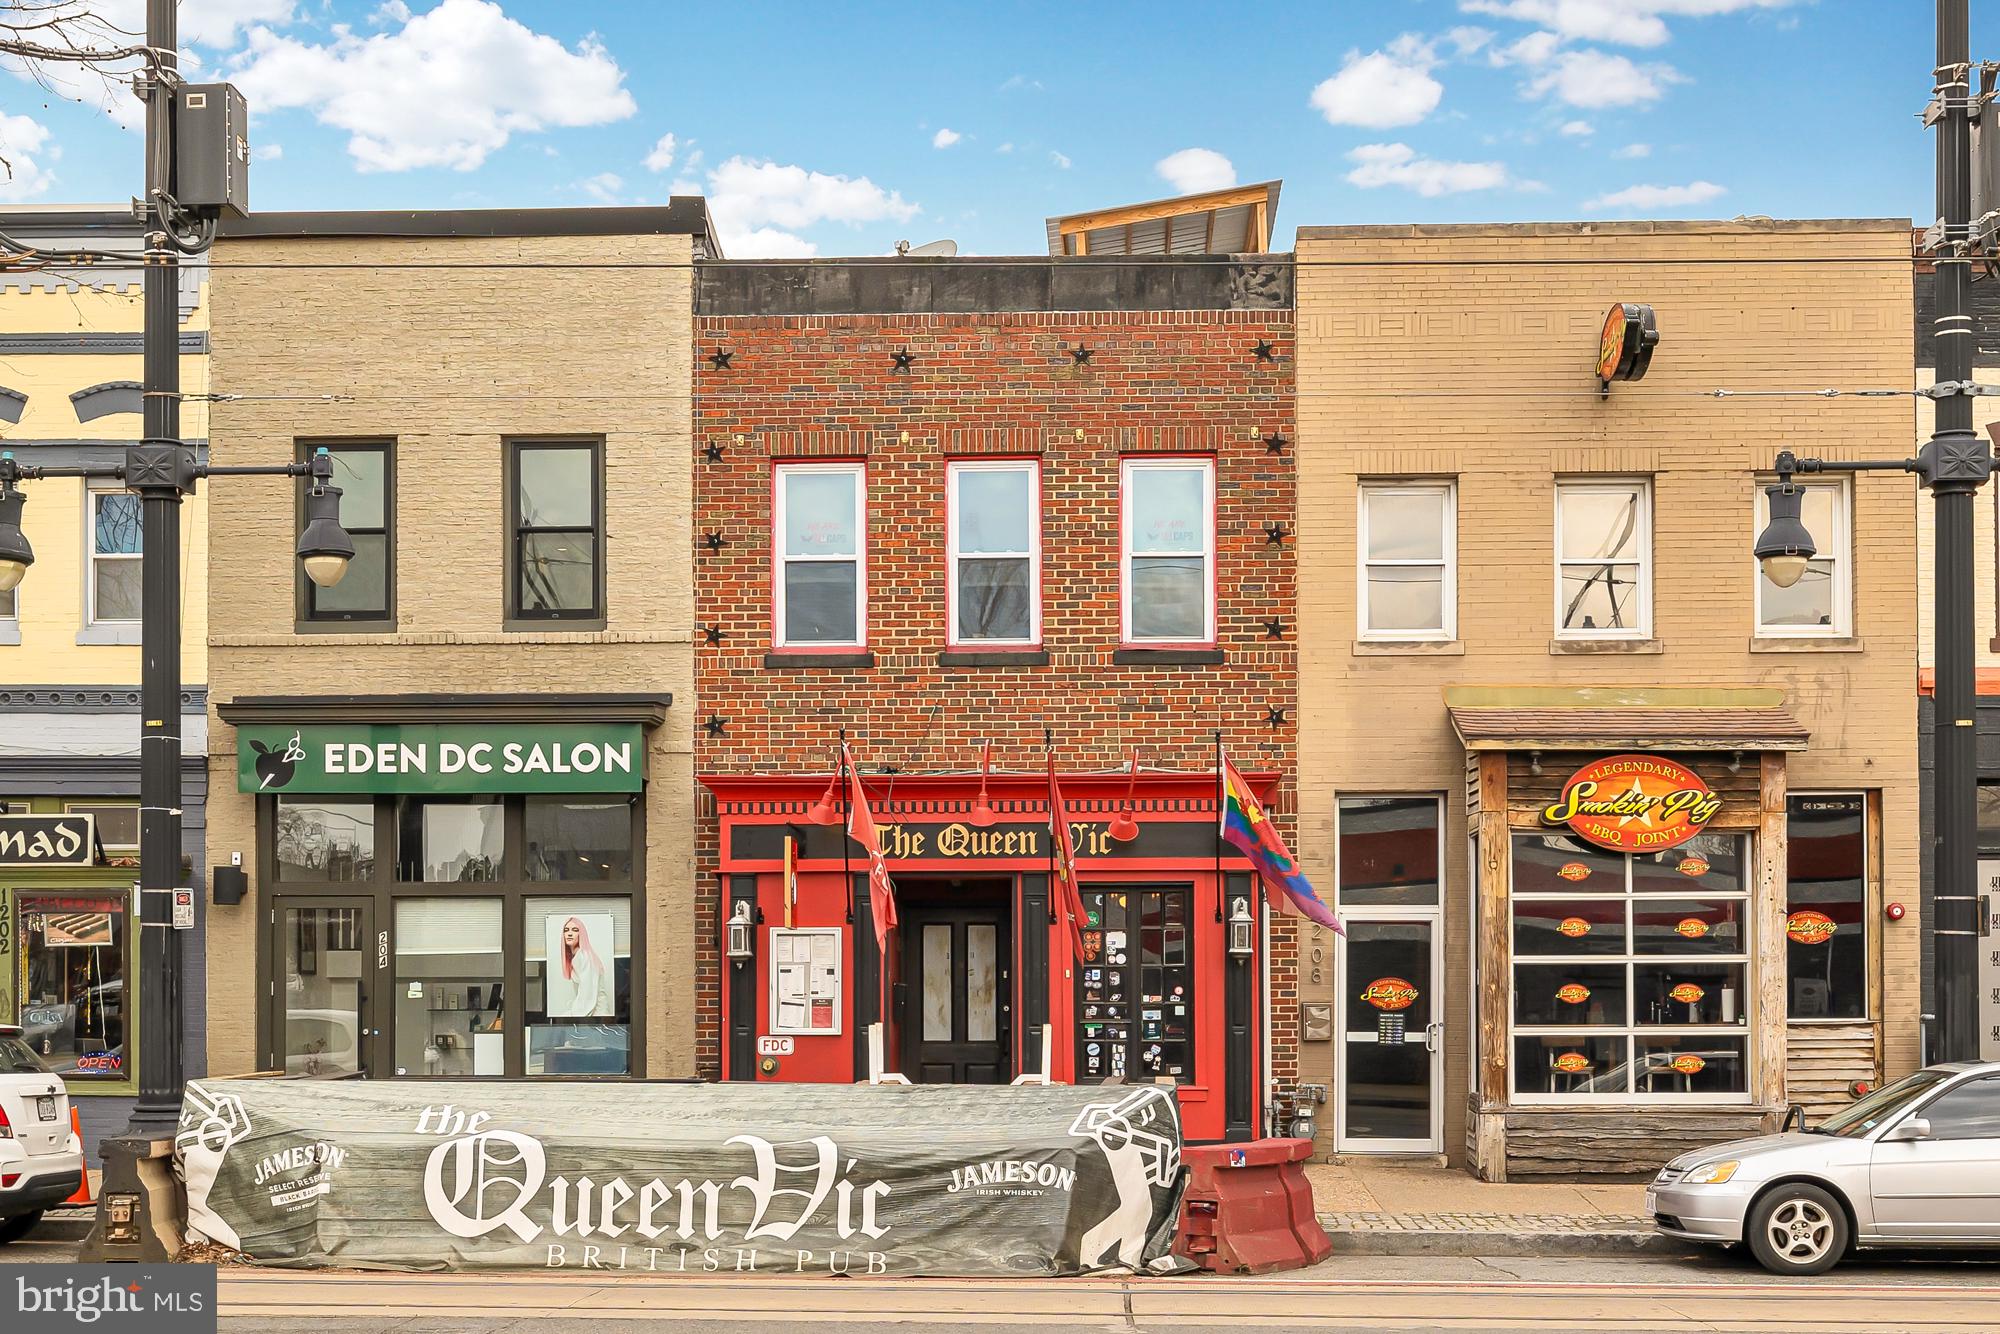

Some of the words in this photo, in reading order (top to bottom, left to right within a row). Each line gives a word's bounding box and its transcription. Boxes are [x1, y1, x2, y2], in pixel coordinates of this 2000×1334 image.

[323, 742, 426, 774] EDEN
[439, 742, 493, 774] DC
[502, 741, 631, 774] SALON
[1594, 761, 1682, 782] LEGENDARY
[1543, 780, 1659, 822] Smokin'
[1661, 788, 1724, 824] Pig
[874, 823, 926, 860] The
[937, 823, 1038, 858] Queen
[1590, 823, 1623, 846] BBQ
[1633, 826, 1682, 847] JOINT
[379, 931, 387, 969] 204
[1311, 924, 1323, 983] 208
[763, 1039, 788, 1052] FDC
[77, 1057, 122, 1070] OPEN
[414, 1103, 493, 1137] the
[254, 1142, 346, 1185] JAMESON
[947, 1160, 1077, 1193] JAMESON
[268, 1181, 296, 1194] SELECT
[279, 1191, 301, 1203] BLACK
[423, 1129, 725, 1245] Queen
[723, 1134, 893, 1242] Vic
[545, 1244, 758, 1272] BRITISH
[795, 1250, 887, 1275] PUB
